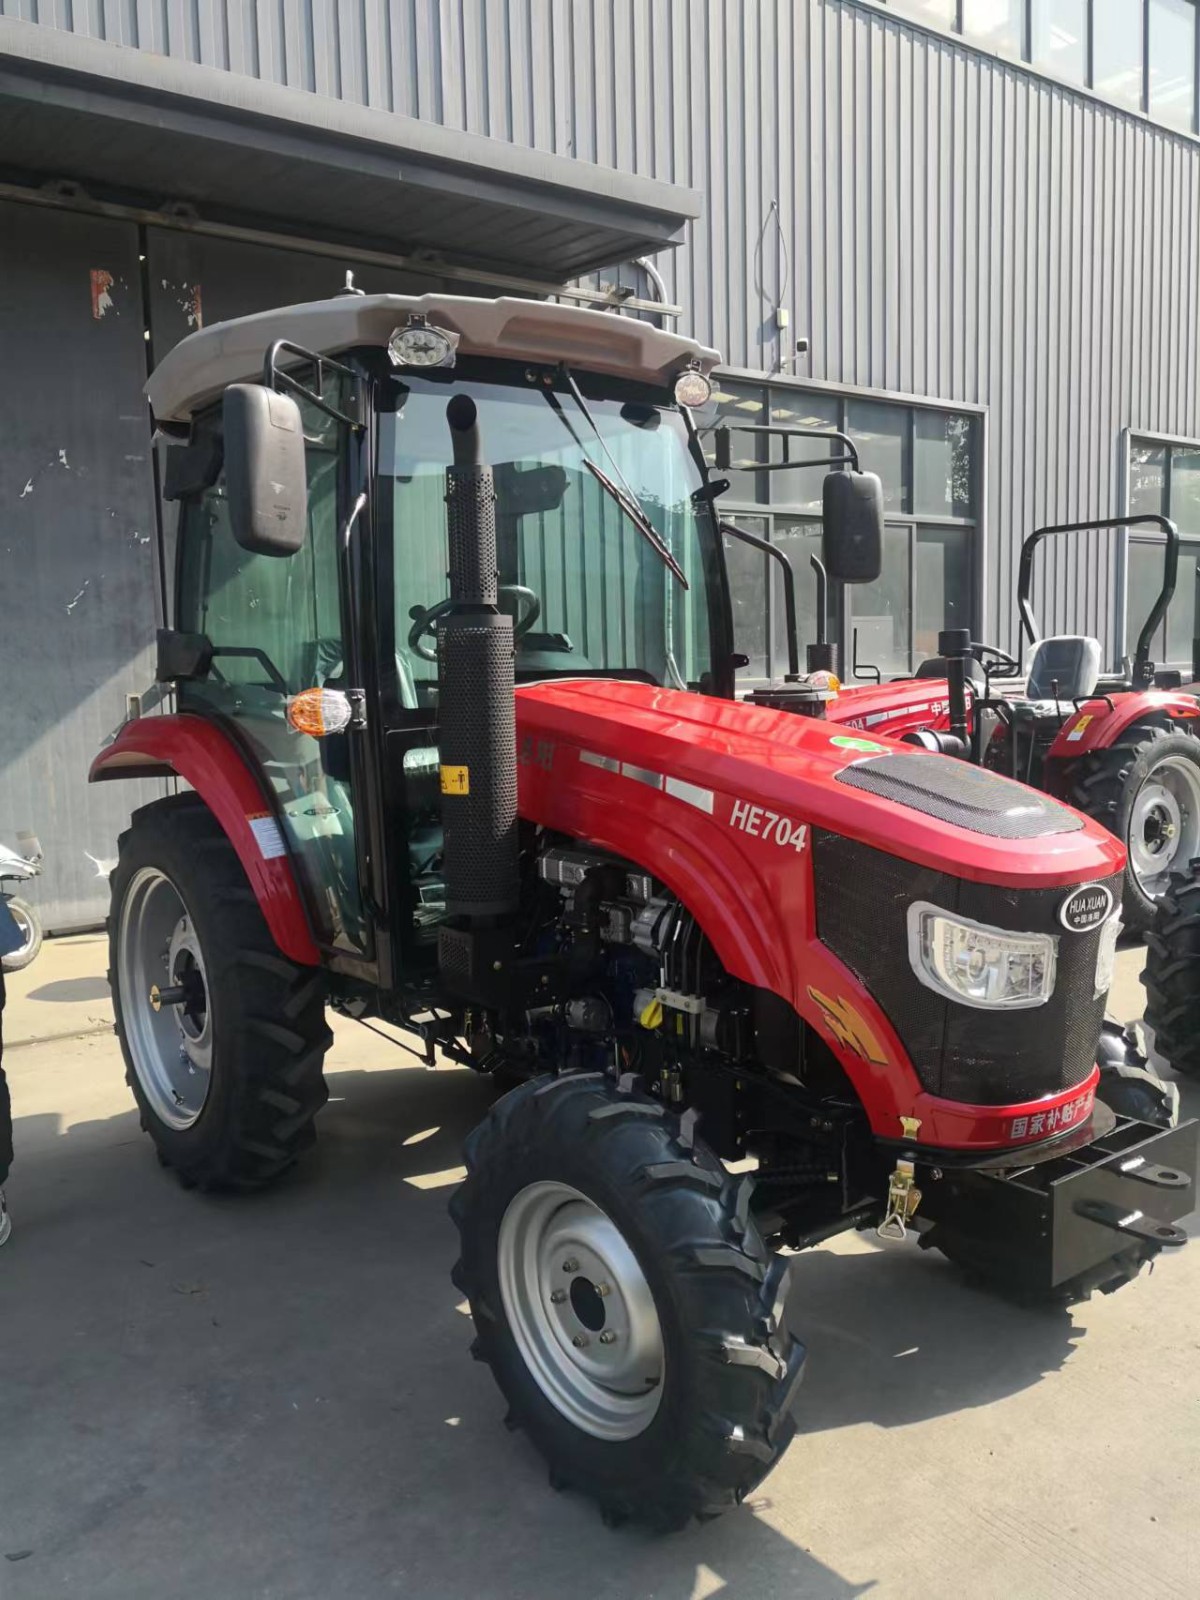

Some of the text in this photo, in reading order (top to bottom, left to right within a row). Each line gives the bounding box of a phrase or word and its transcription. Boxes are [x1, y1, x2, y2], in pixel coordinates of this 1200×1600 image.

[730, 799, 808, 853] HE704
[1069, 894, 1107, 914] HUA XUAN
[1010, 1088, 1094, 1139] 国家补贴产品
